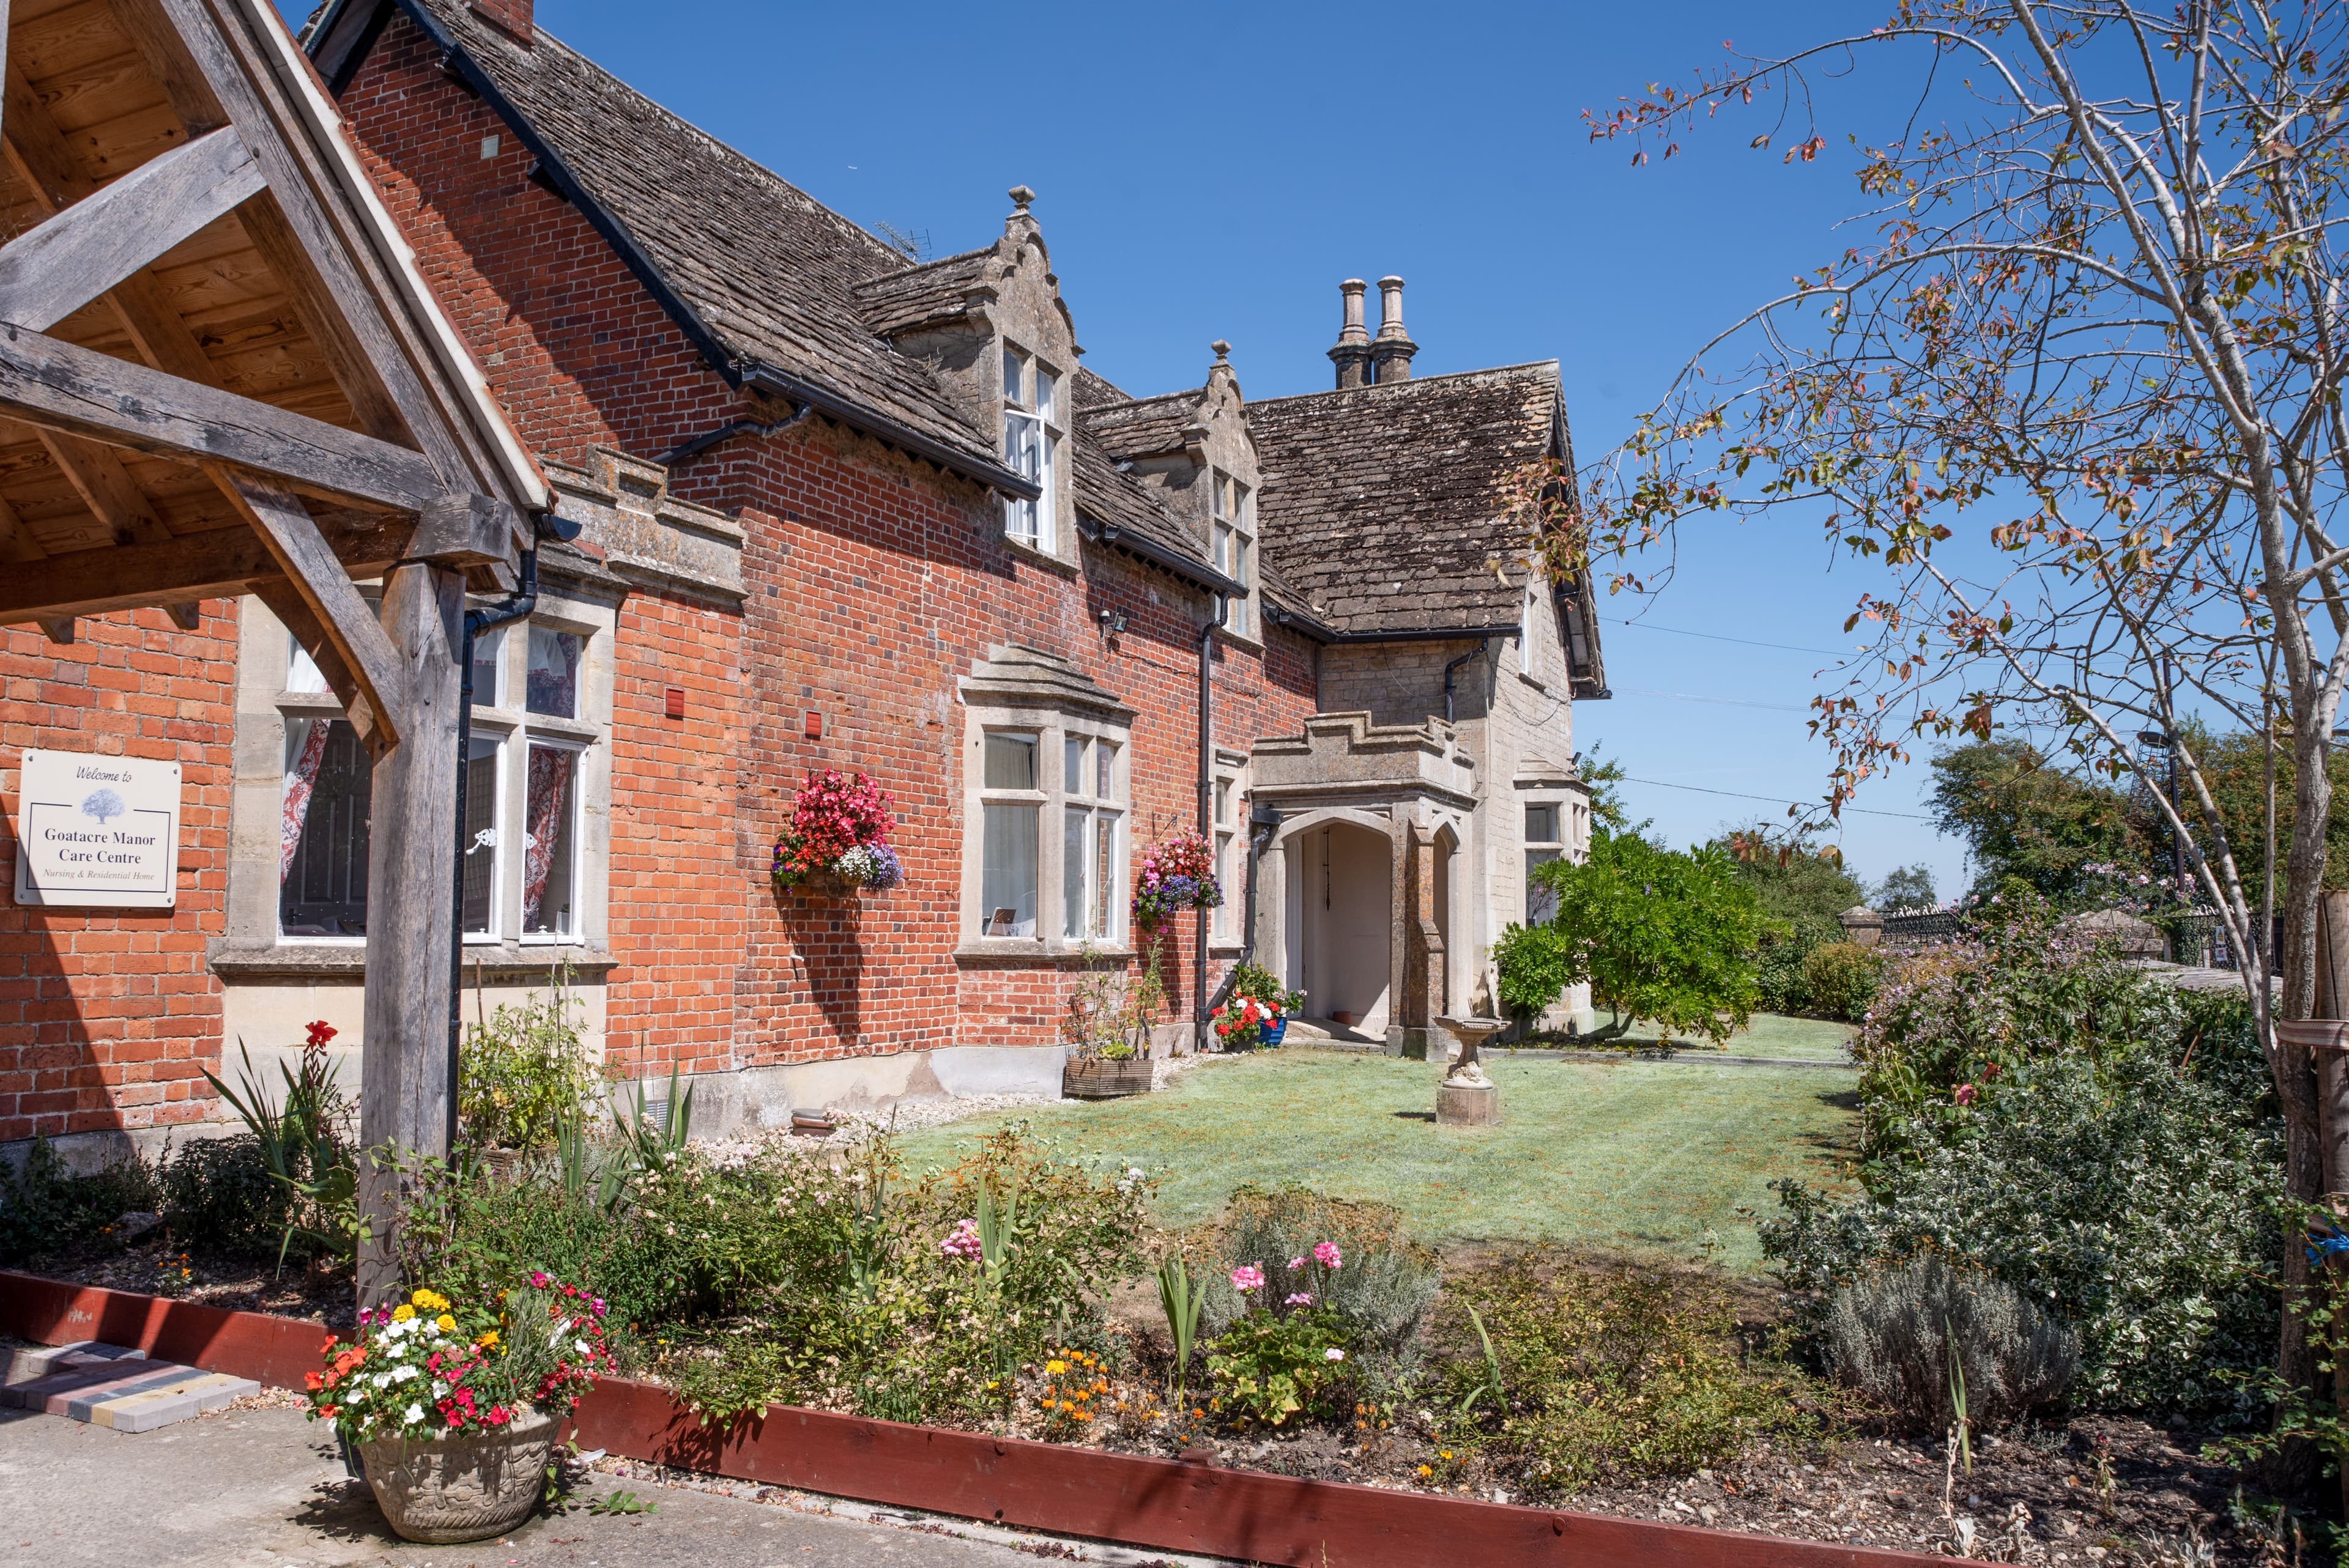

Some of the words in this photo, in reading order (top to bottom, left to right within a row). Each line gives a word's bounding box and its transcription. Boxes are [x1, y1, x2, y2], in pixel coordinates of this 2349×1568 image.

[76, 766, 119, 782] Welcome
[123, 771, 132, 782] to
[45, 828, 108, 843] Goatacre
[113, 832, 156, 845] Manor
[59, 849, 92, 862] Care
[97, 851, 141, 864] Centre
[43, 869, 75, 879] Nursing
[87, 871, 130, 879] Residential
